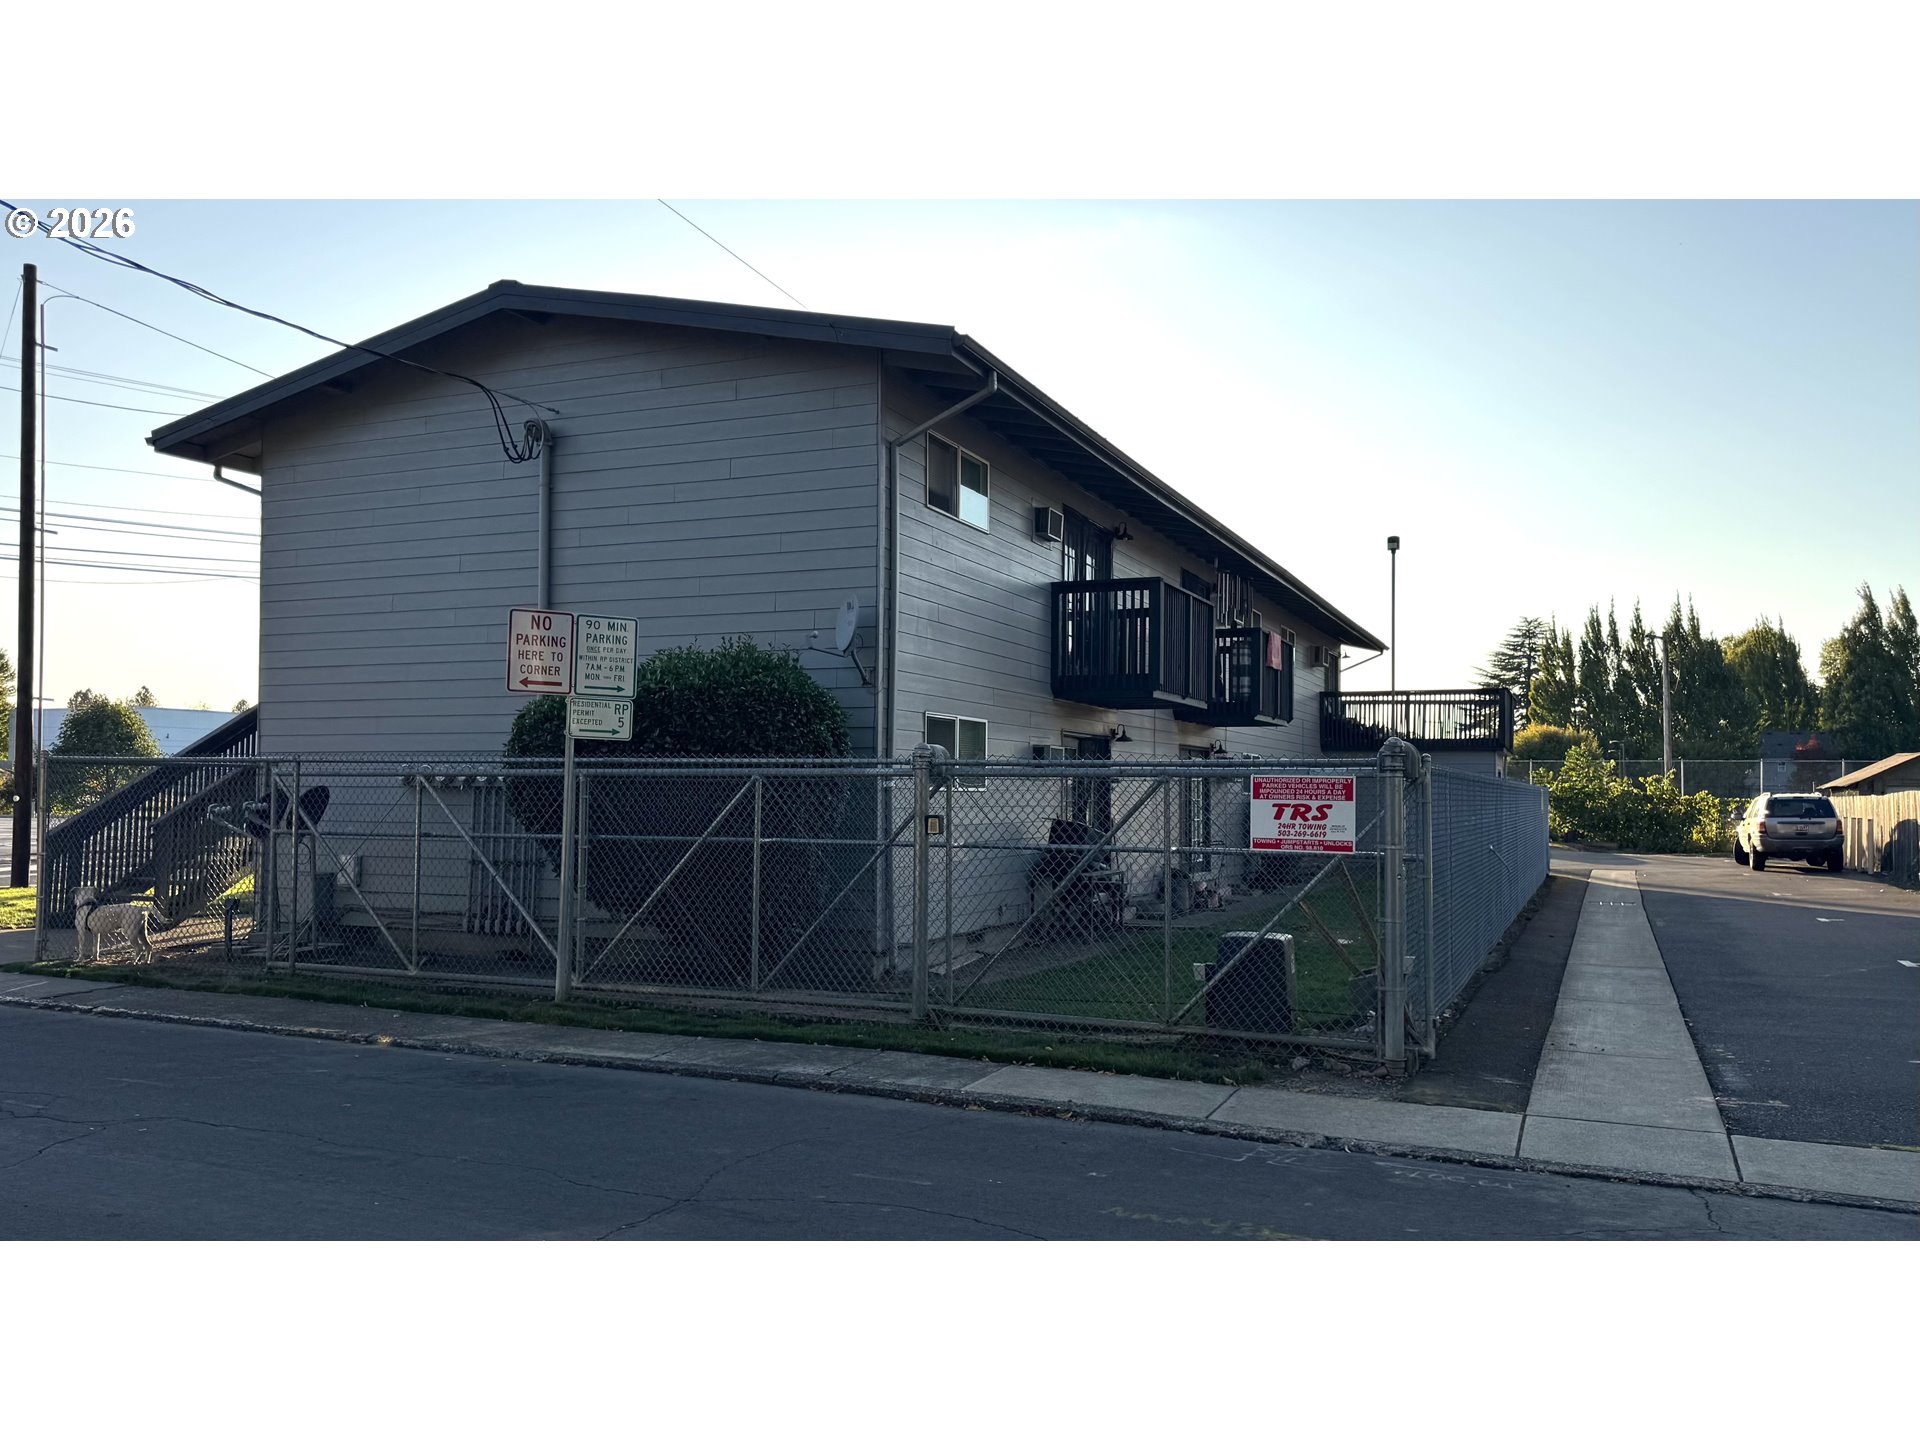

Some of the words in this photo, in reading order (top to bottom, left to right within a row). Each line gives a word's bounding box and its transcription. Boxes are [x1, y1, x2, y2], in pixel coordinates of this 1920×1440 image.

[531, 614, 552, 631] NO
[586, 620, 601, 630] 90
[515, 633, 567, 648] PARKING
[586, 633, 628, 645] PARKING
[518, 649, 545, 661] HERE
[551, 651, 564, 662] TO
[586, 646, 601, 654] ONCE
[519, 664, 561, 676] CORNER
[613, 674, 625, 682] FRI
[572, 700, 611, 709] RESIDENTIAL
[614, 703, 629, 715] RP
[617, 716, 625, 728] 5
[1271, 803, 1334, 822] TRS
[1277, 822, 1297, 830] 24HR
[1298, 823, 1327, 831] TOWING
[1277, 830, 1327, 838] 503-269-6619
